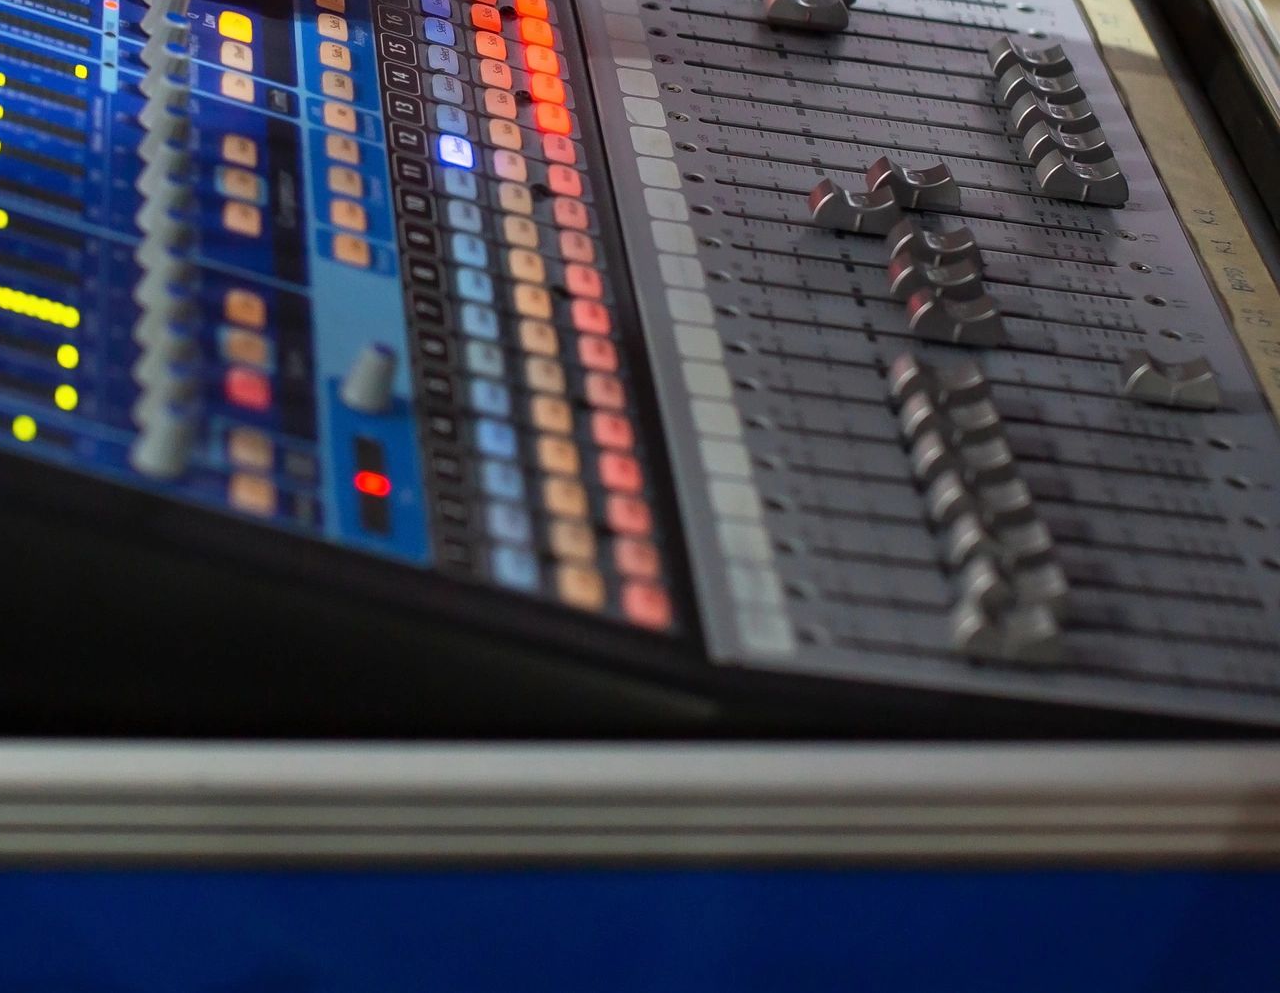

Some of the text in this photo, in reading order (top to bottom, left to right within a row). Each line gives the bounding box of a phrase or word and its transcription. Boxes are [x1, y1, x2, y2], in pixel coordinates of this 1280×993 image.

[202, 13, 216, 28] Low
[386, 13, 403, 26] 16
[436, 21, 446, 34] Select
[389, 41, 407, 54] 15
[440, 47, 450, 63] Select
[392, 70, 411, 84] 14
[396, 102, 413, 115] 13
[398, 131, 417, 146] 12
